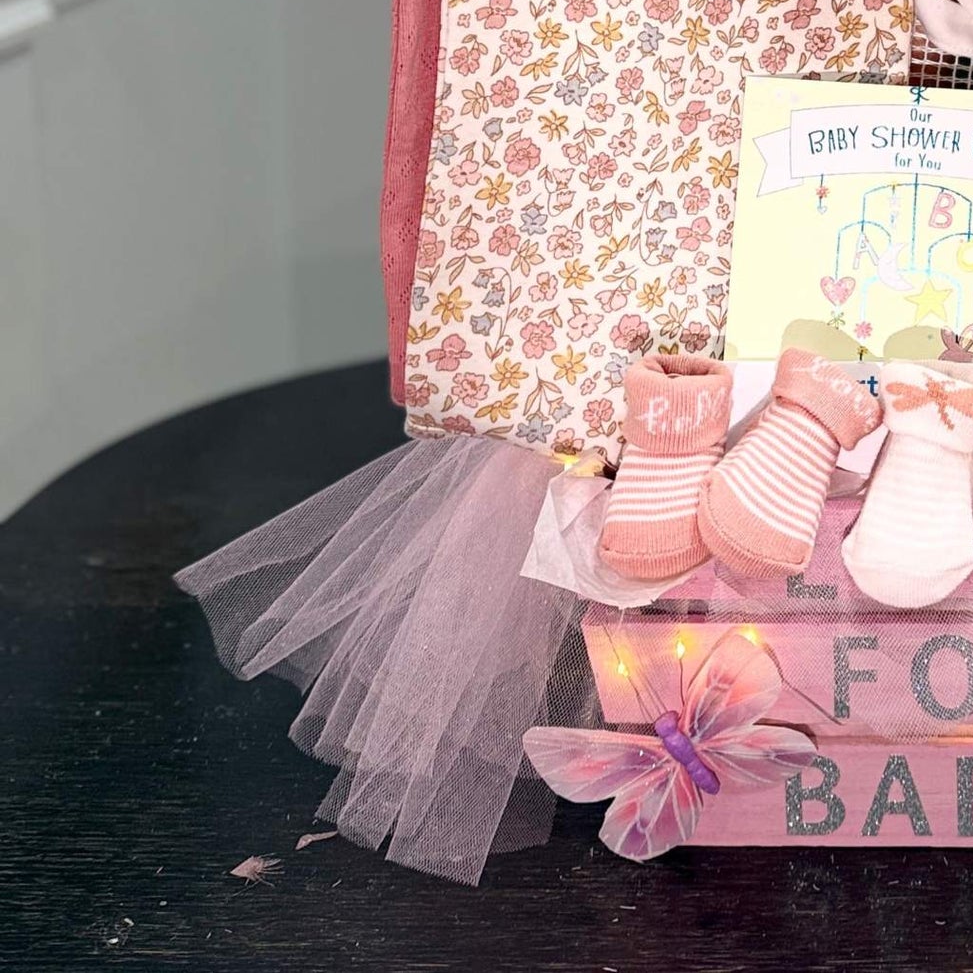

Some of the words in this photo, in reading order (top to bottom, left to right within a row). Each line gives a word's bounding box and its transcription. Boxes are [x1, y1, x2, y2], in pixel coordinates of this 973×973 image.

[910, 108, 932, 123] Our
[808, 125, 859, 155] BABY
[871, 125, 961, 154] SHOWER
[895, 152, 912, 168] for
[918, 153, 942, 171] You
